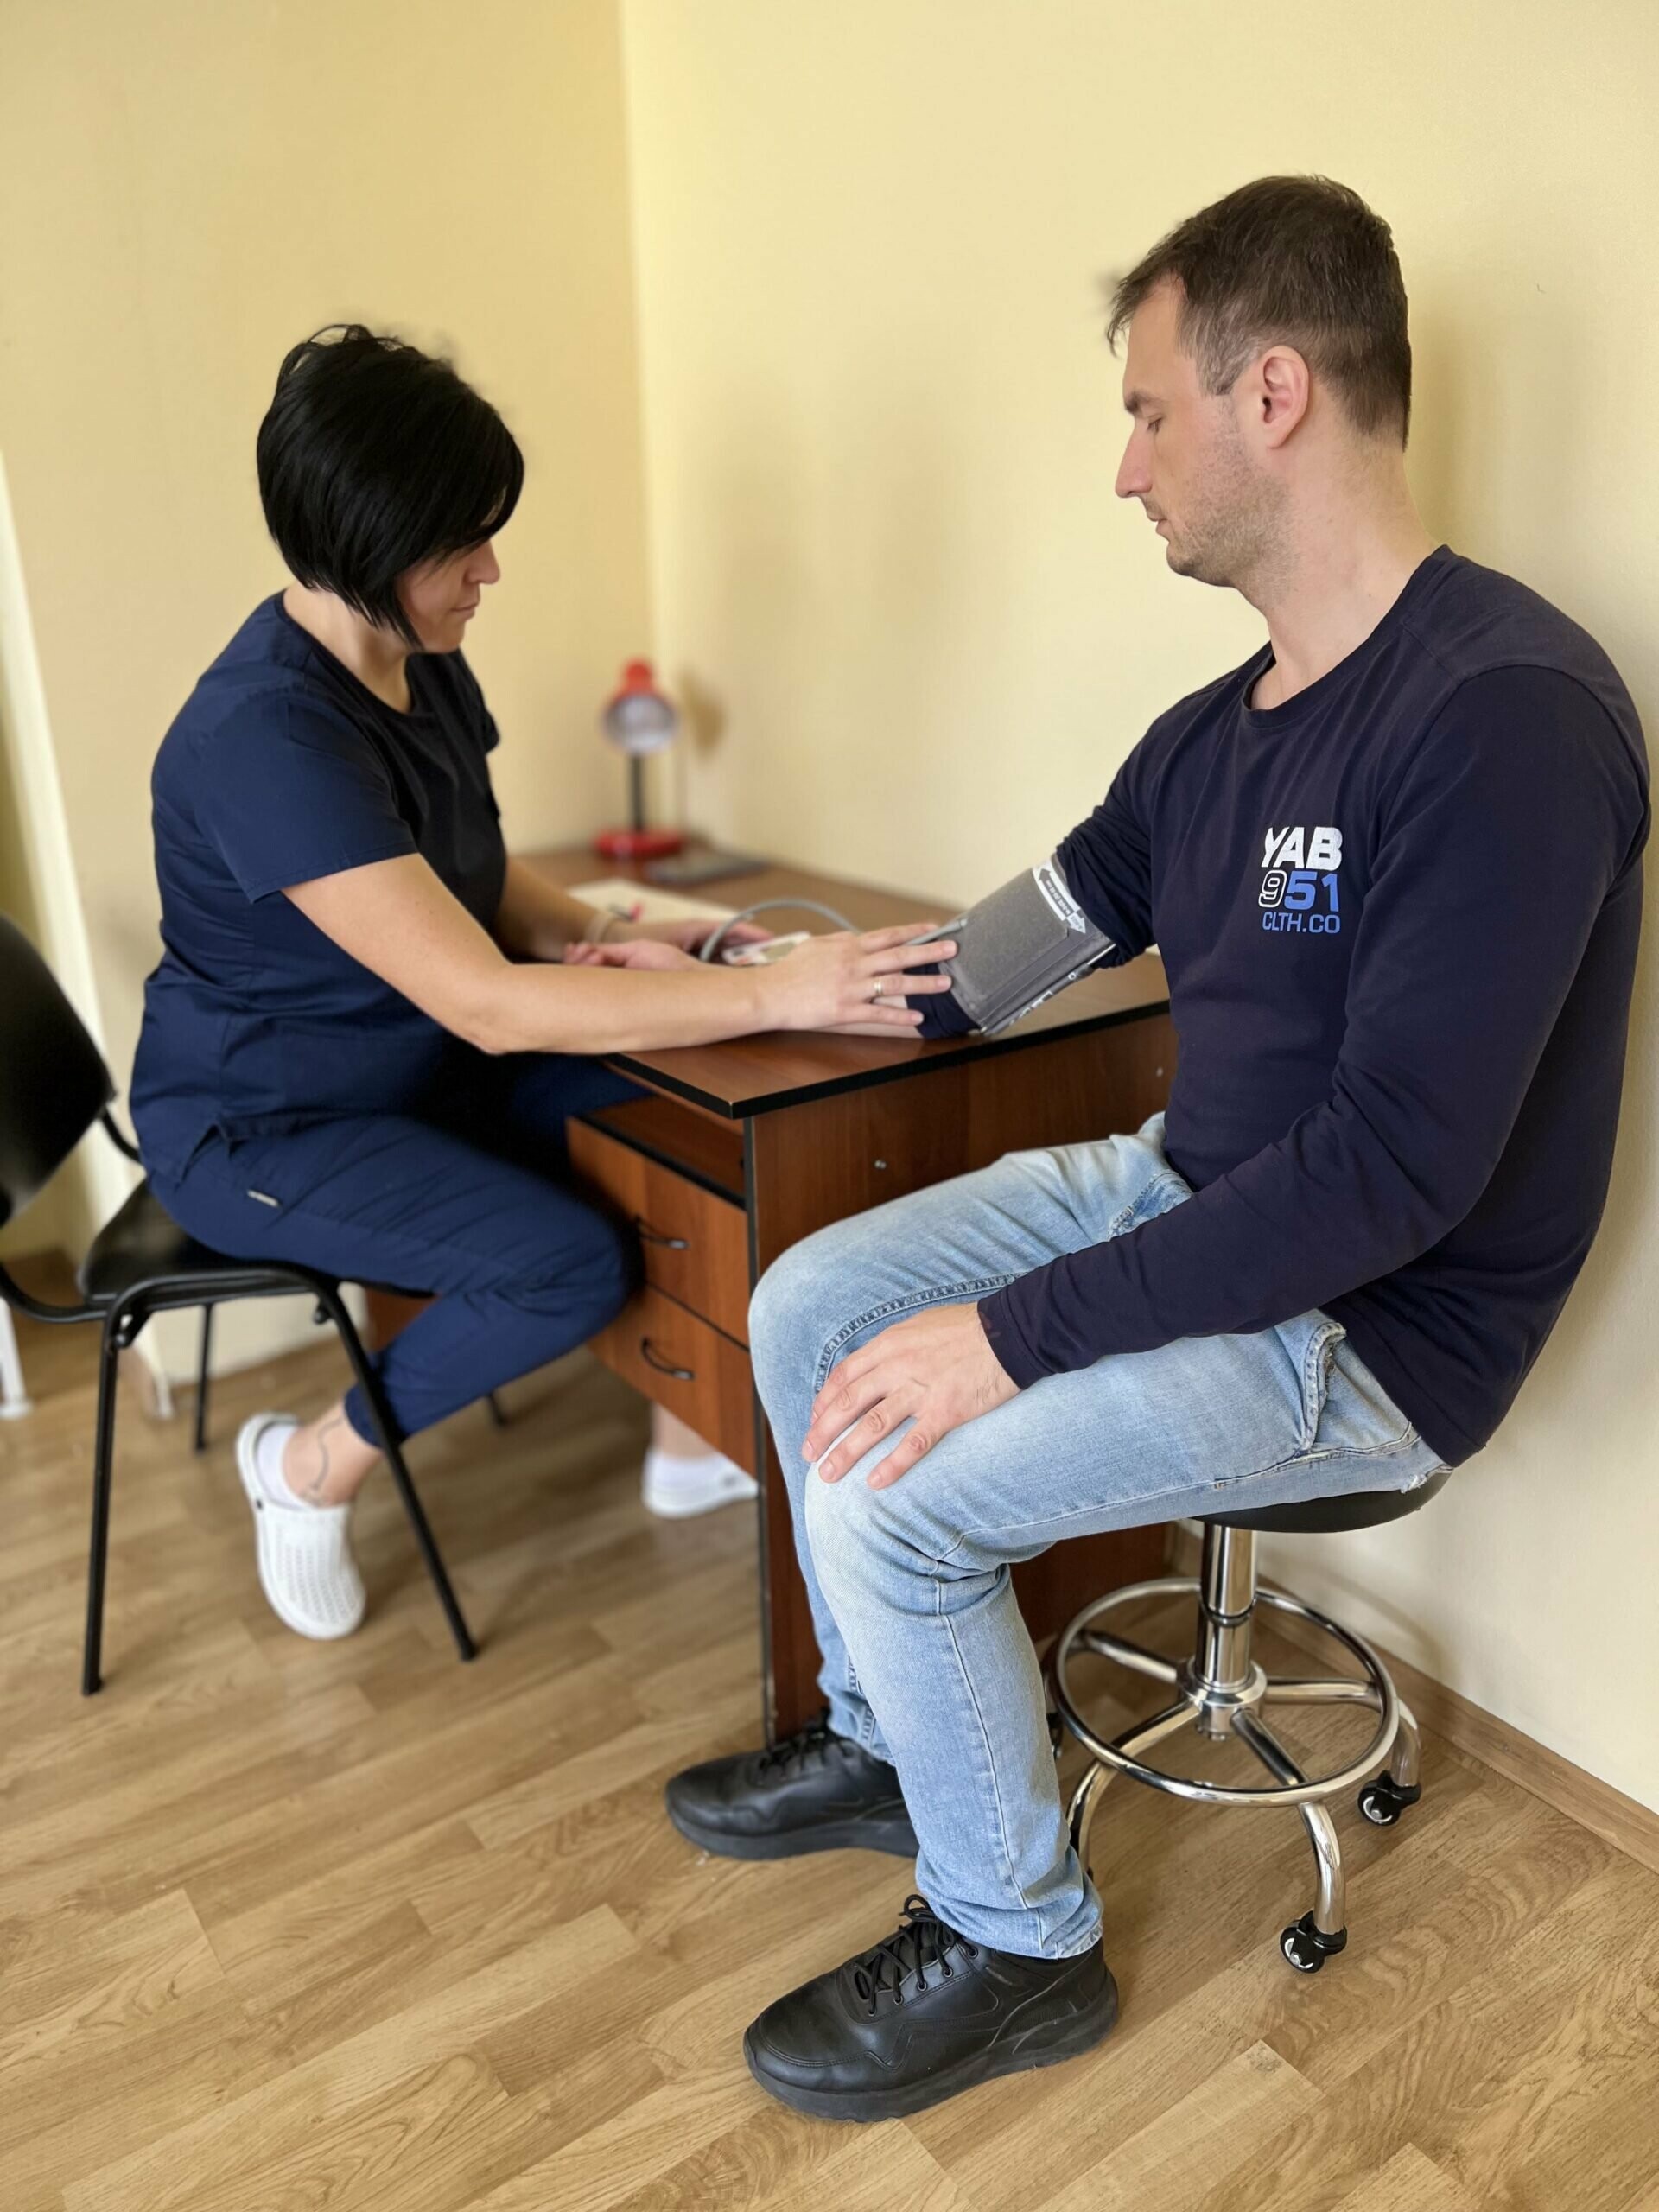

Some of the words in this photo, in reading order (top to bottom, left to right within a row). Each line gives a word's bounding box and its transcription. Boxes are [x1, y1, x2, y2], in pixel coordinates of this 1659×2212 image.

[1261, 826, 1343, 871] YAB
[1258, 869, 1339, 912] 951
[1262, 912, 1340, 933] CLTH.CO
